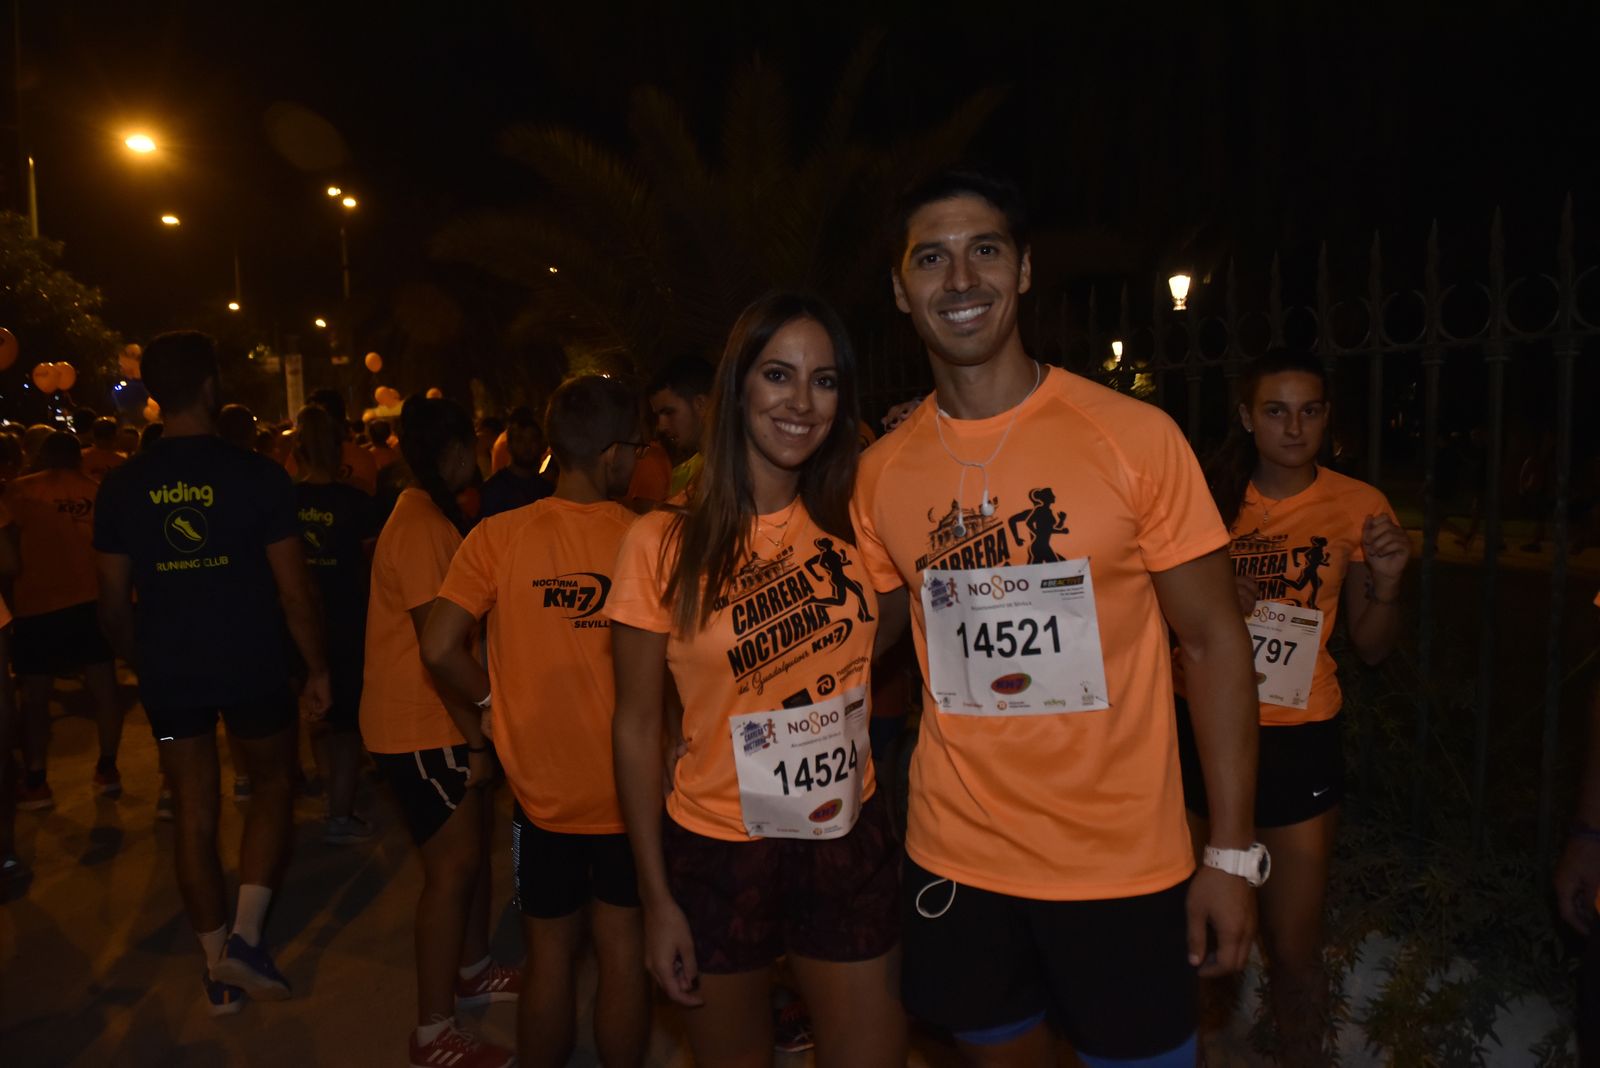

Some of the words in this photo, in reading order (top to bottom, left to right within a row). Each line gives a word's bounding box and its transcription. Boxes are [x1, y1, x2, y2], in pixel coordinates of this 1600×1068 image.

[149, 480, 214, 507] viding
[156, 559, 200, 572] RUNNING
[203, 555, 229, 568] CLUB
[931, 528, 1010, 570] RRERA
[732, 570, 814, 635] CARRERA
[1253, 606, 1286, 623] O8DO
[574, 620, 609, 628] SEVILL
[727, 605, 831, 678] NOCTURNA
[957, 615, 1061, 658] 14521
[774, 740, 857, 796] 14524
